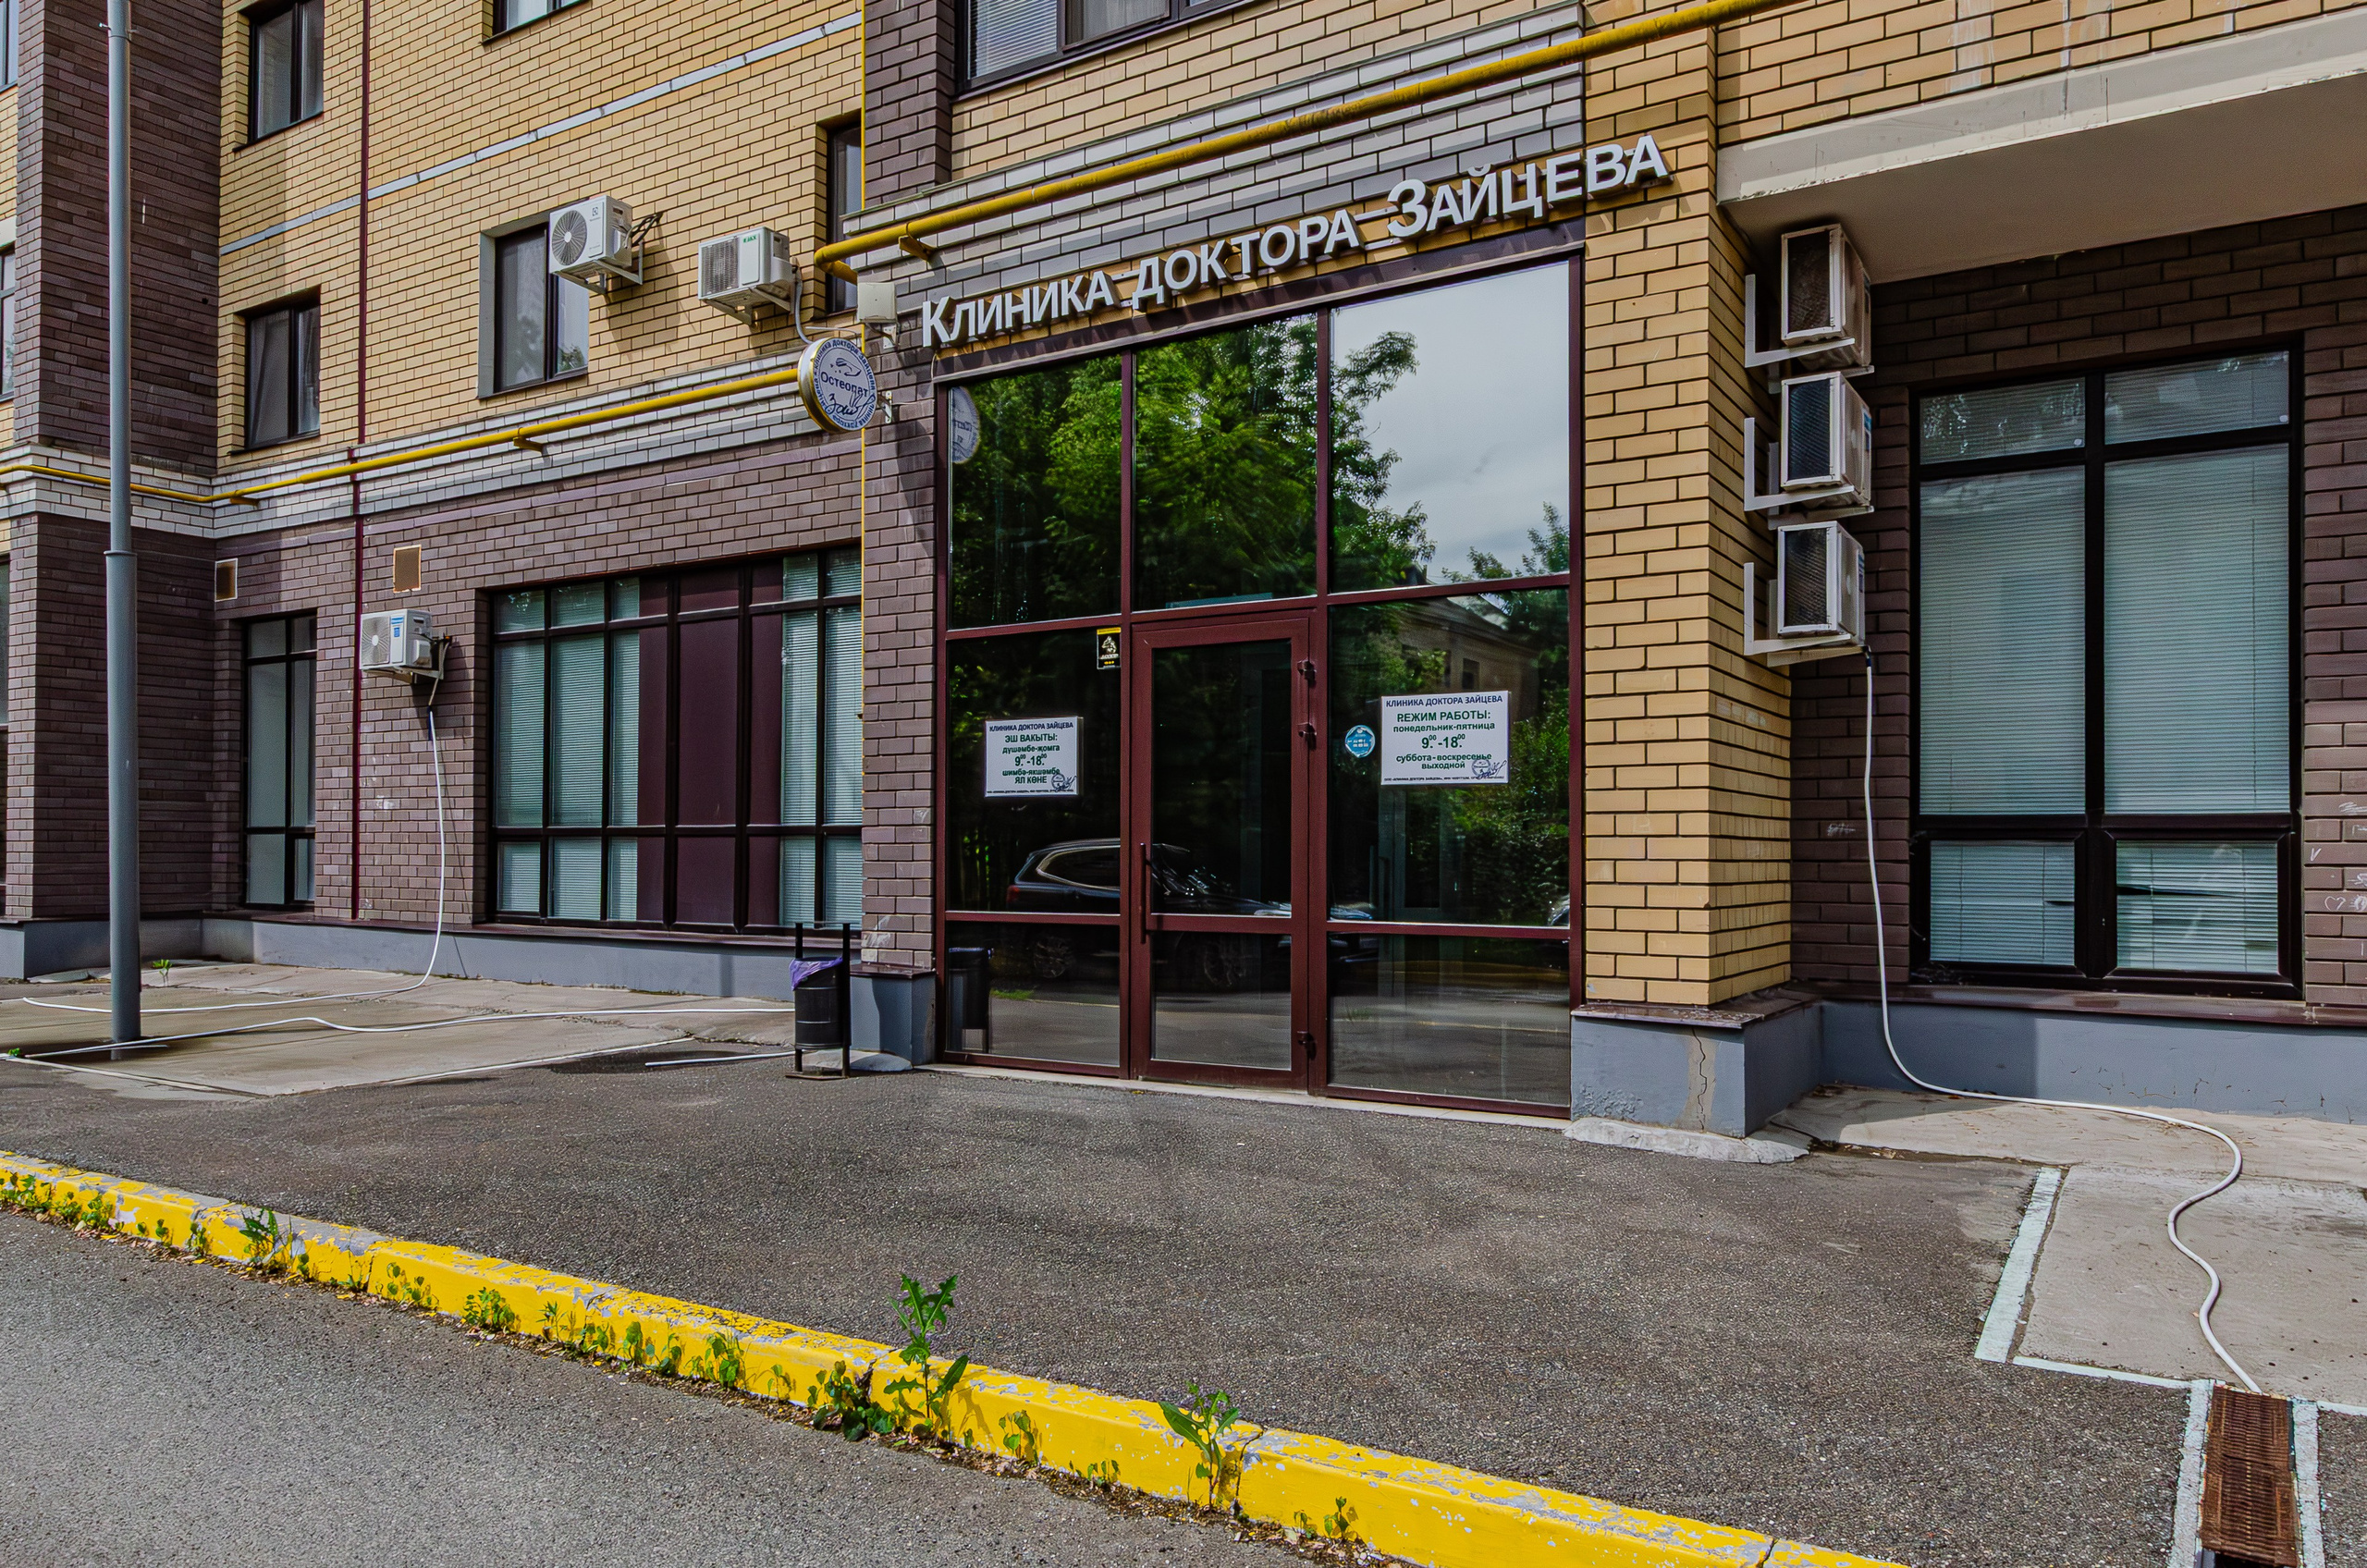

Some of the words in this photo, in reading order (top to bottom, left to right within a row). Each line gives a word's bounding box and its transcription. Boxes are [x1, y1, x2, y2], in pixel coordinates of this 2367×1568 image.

[922, 270, 1115, 348] КЛИНИКА
[1132, 209, 1360, 310] ДОКТОРА
[1386, 134, 1669, 238] ЗАЙЦЕВА
[820, 371, 869, 398] Остеопат
[1386, 698, 1425, 708] КЛИНИКА
[1425, 696, 1464, 707] ДОКТОРА
[1465, 694, 1503, 705] ЗАЙЦЕВА
[1397, 711, 1437, 723] РЕЖИМ
[1440, 709, 1490, 721] РАБОТЫ:
[989, 724, 1017, 732] КЛИНИКА
[1018, 723, 1046, 731] ДОКТОРА
[1046, 721, 1073, 730] ЗАЙЦЕВА
[1392, 723, 1495, 733] понедельник-пятница
[1004, 735, 1019, 743] ЭШ
[1020, 733, 1058, 742] ВАКЫТЫ:
[1421, 761, 1466, 769] выходной
[1014, 776, 1025, 784] ЯЛ
[1026, 776, 1048, 784] КӨНЕ
